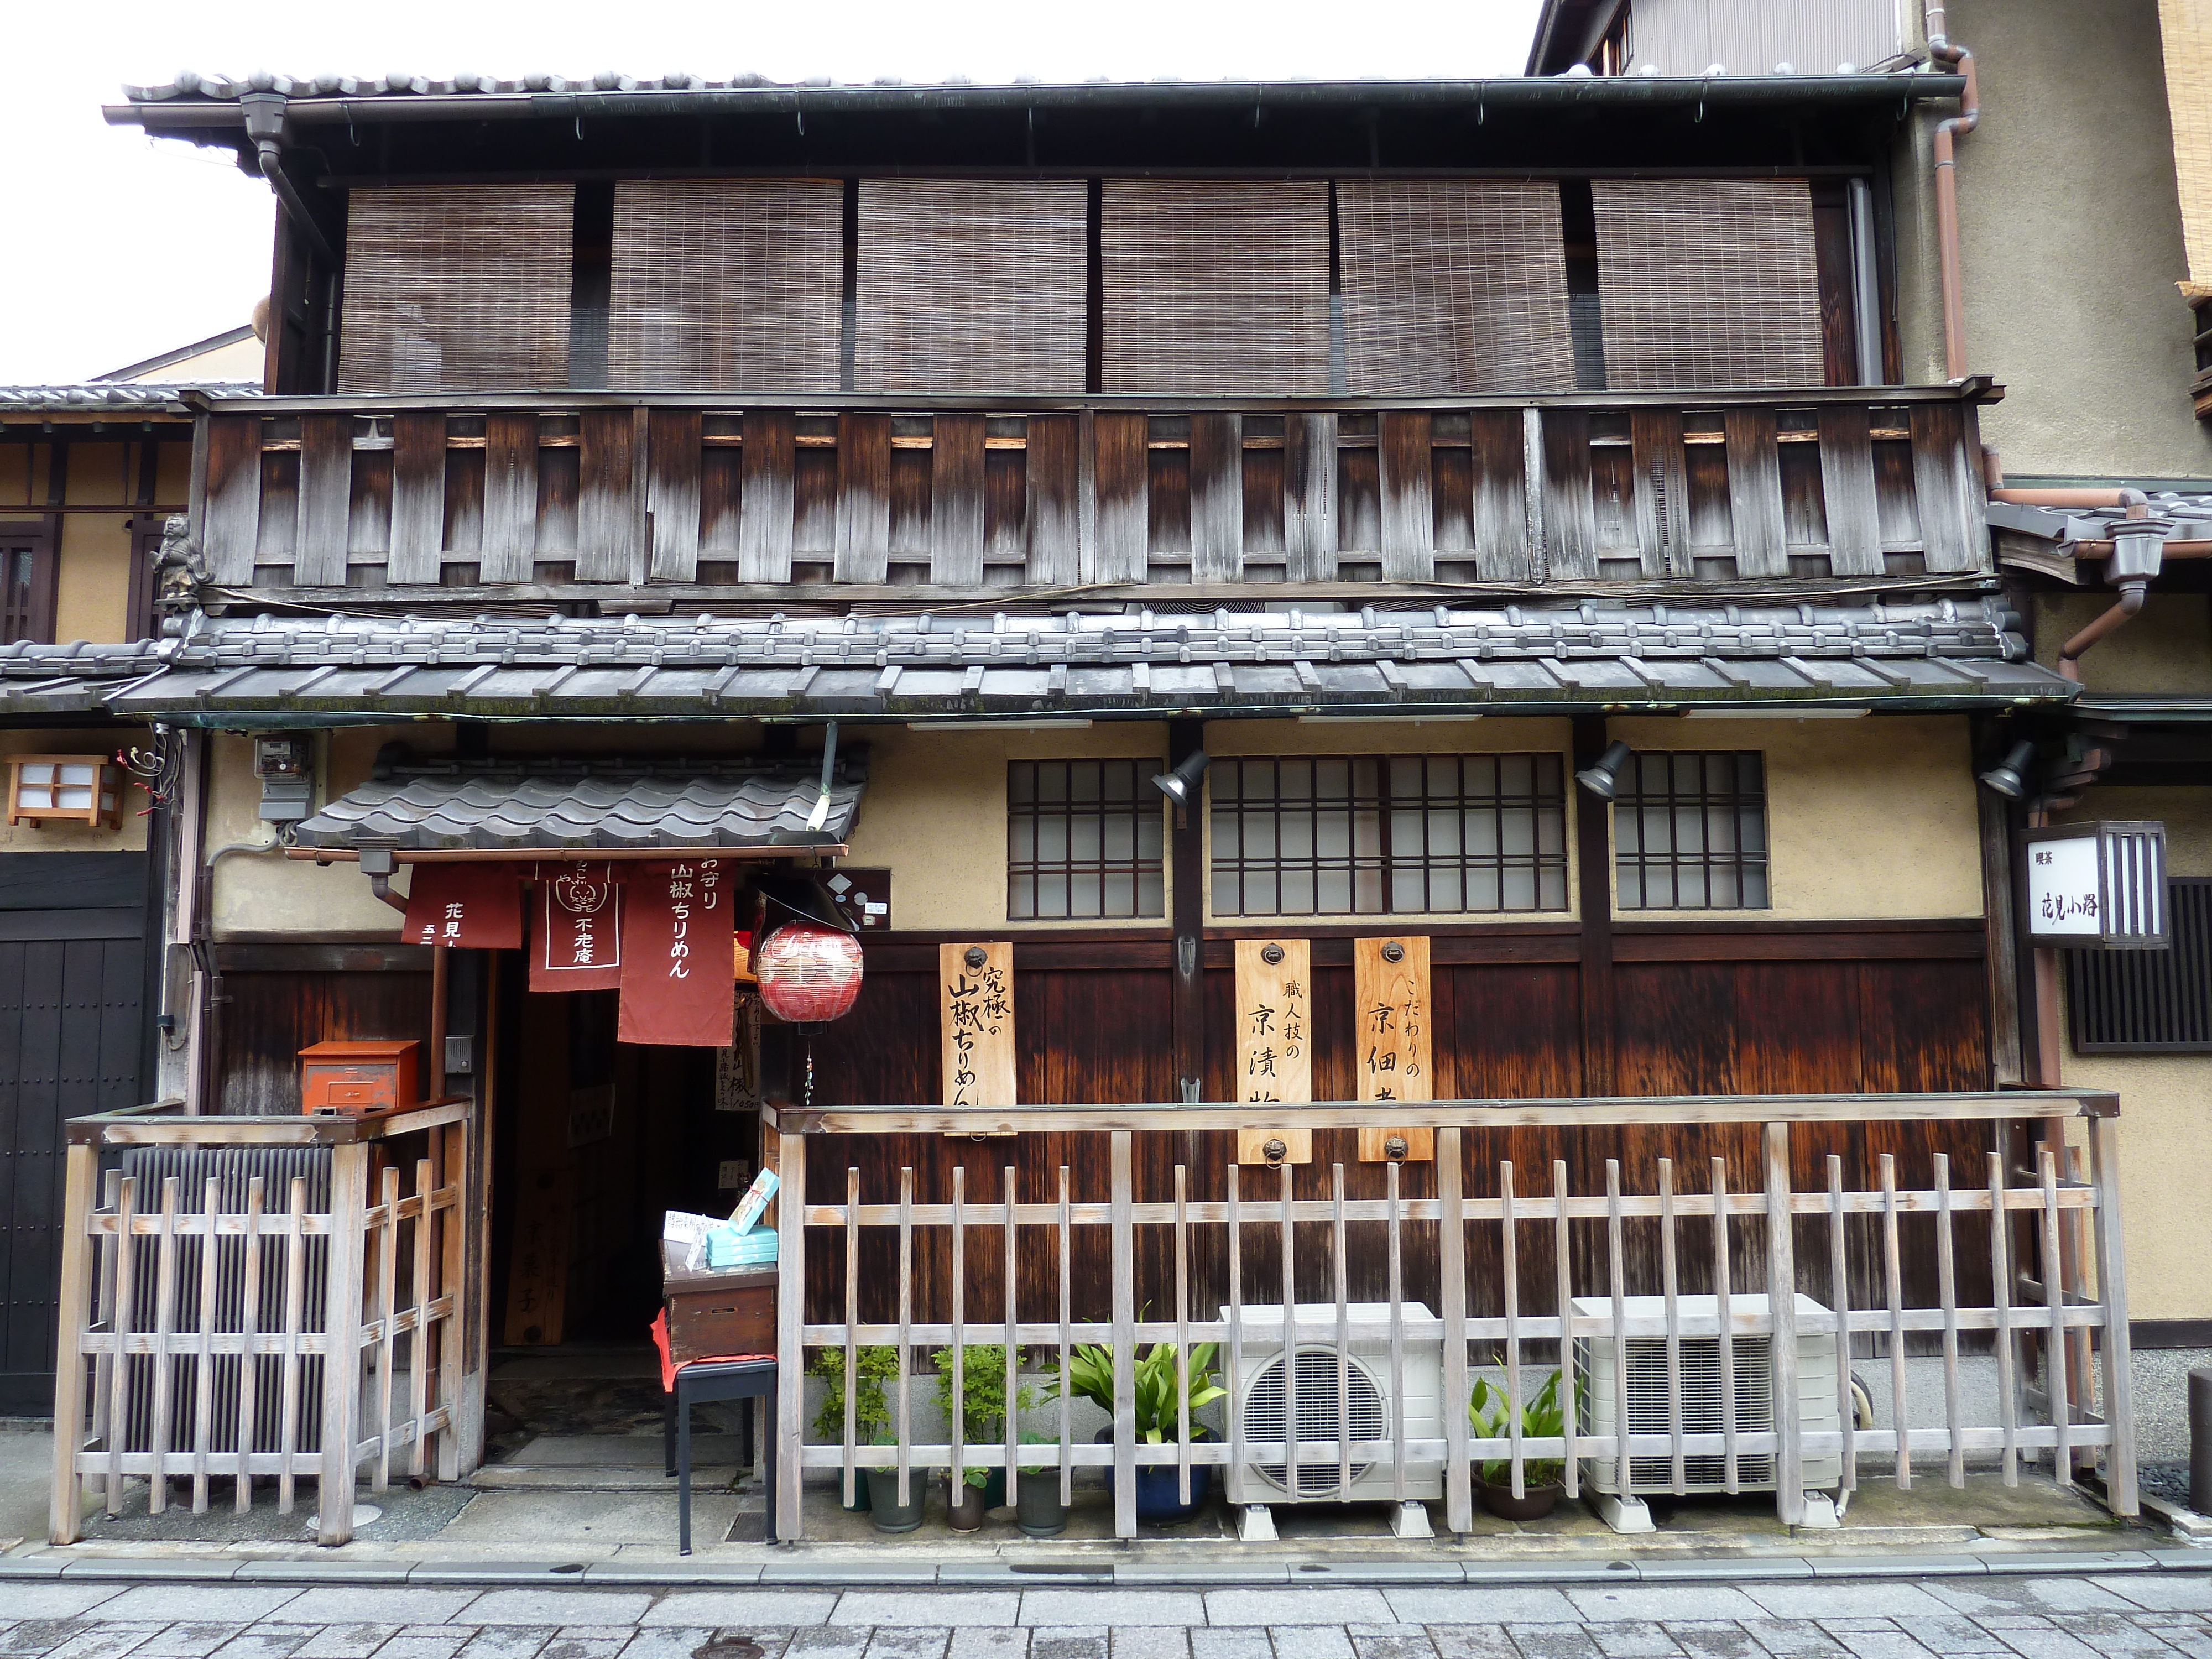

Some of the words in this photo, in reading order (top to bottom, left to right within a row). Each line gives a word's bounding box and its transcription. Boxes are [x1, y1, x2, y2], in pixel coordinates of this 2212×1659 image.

[700, 858, 719, 909] お守り
[2035, 851, 2052, 865] 喫茶
[669, 864, 694, 978] 山椒ちりめん
[2041, 892, 2098, 925] 花見小路
[573, 918, 593, 964] 不老庵
[981, 966, 1011, 1036] 究極の
[1282, 980, 1303, 1059] 職人技の
[1405, 980, 1422, 1078] こだわりの
